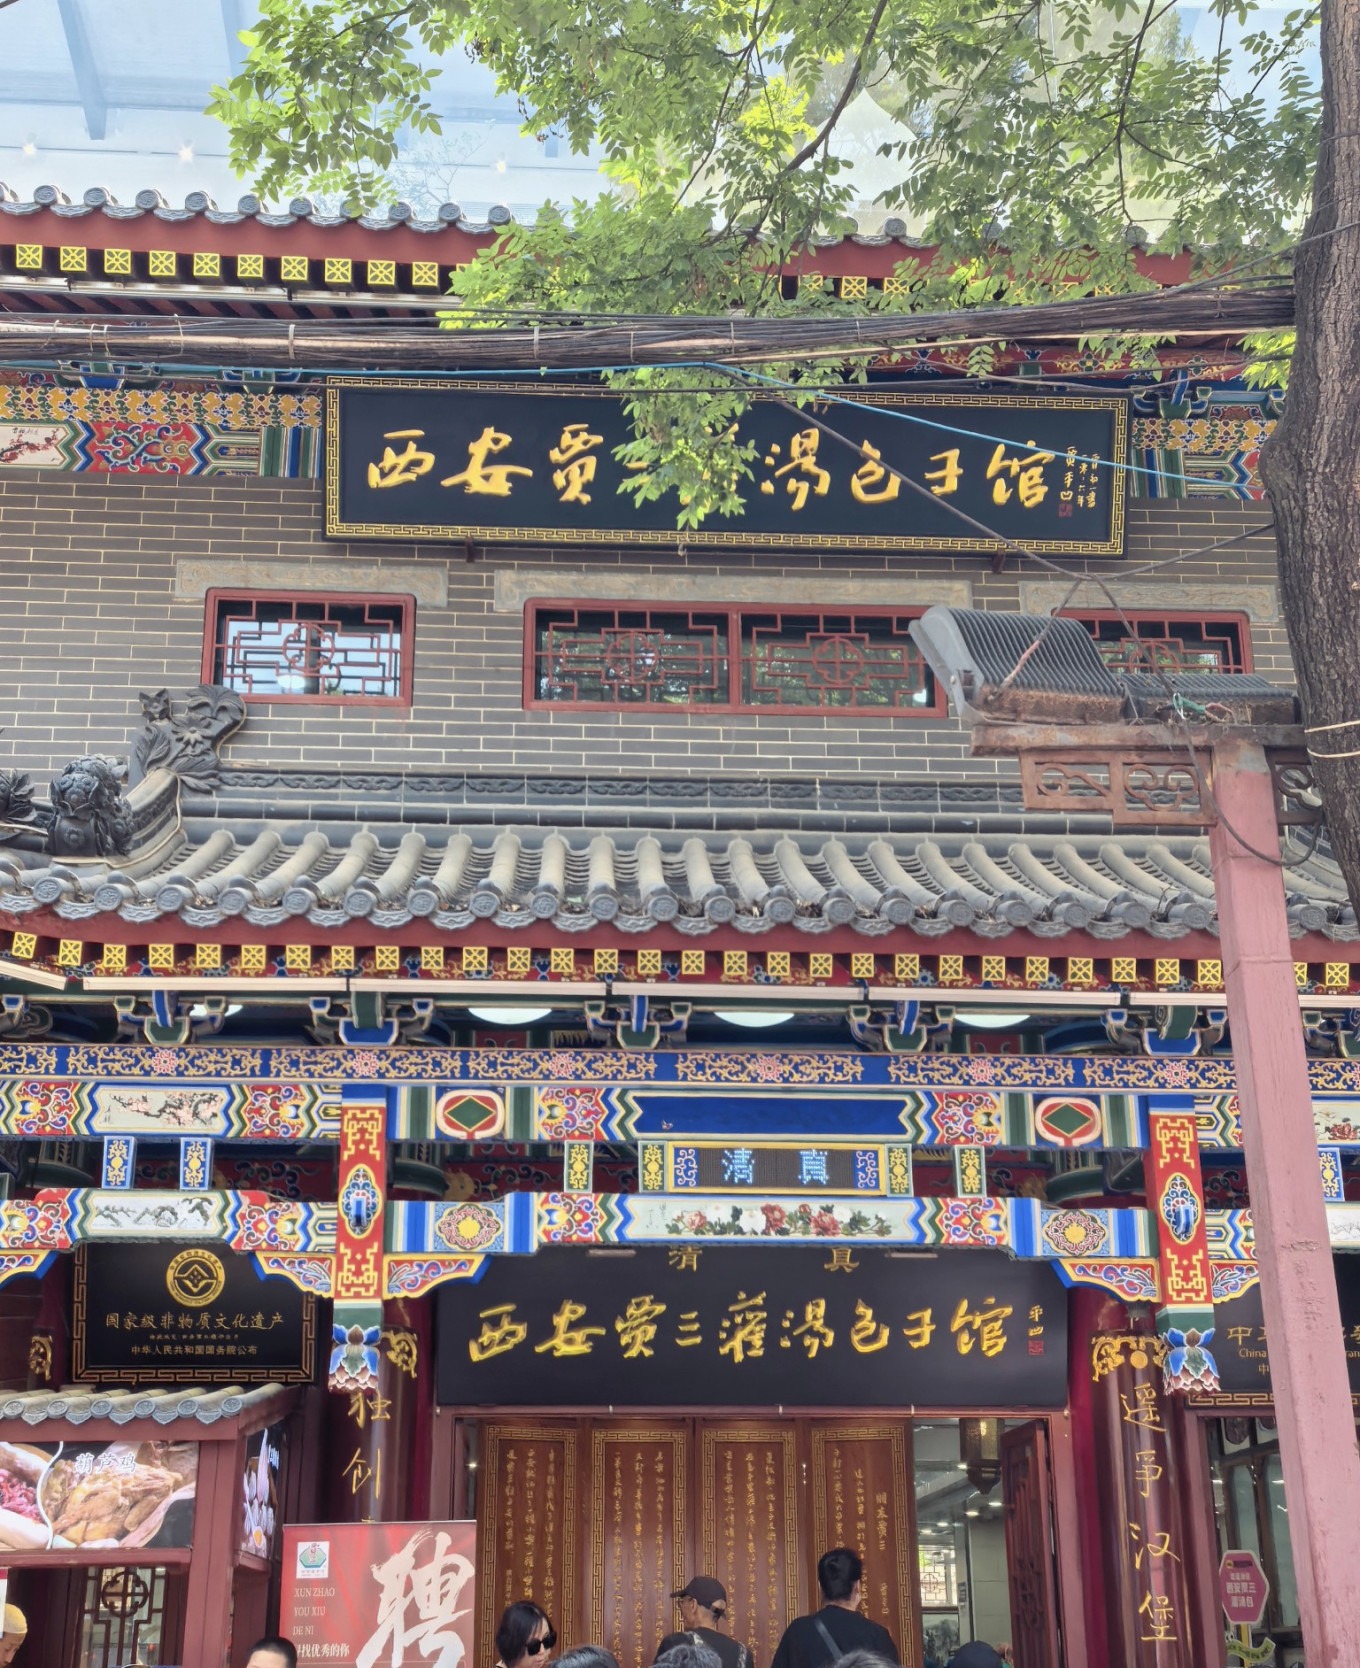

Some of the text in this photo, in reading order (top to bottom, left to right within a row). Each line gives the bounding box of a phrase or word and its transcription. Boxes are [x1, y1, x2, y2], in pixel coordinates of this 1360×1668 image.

[105, 1311, 285, 1330] 国家级非物质文化遗产
[131, 1344, 258, 1356] 中华人民共和国国务院公布
[1238, 1348, 1267, 1358] China
[342, 1389, 393, 1523] 独创
[75, 1452, 137, 1474] 葫芦鸡
[294, 1587, 335, 1597] XUN ZHAO
[293, 1606, 326, 1616] YOU XIU
[293, 1625, 314, 1636] DE NI
